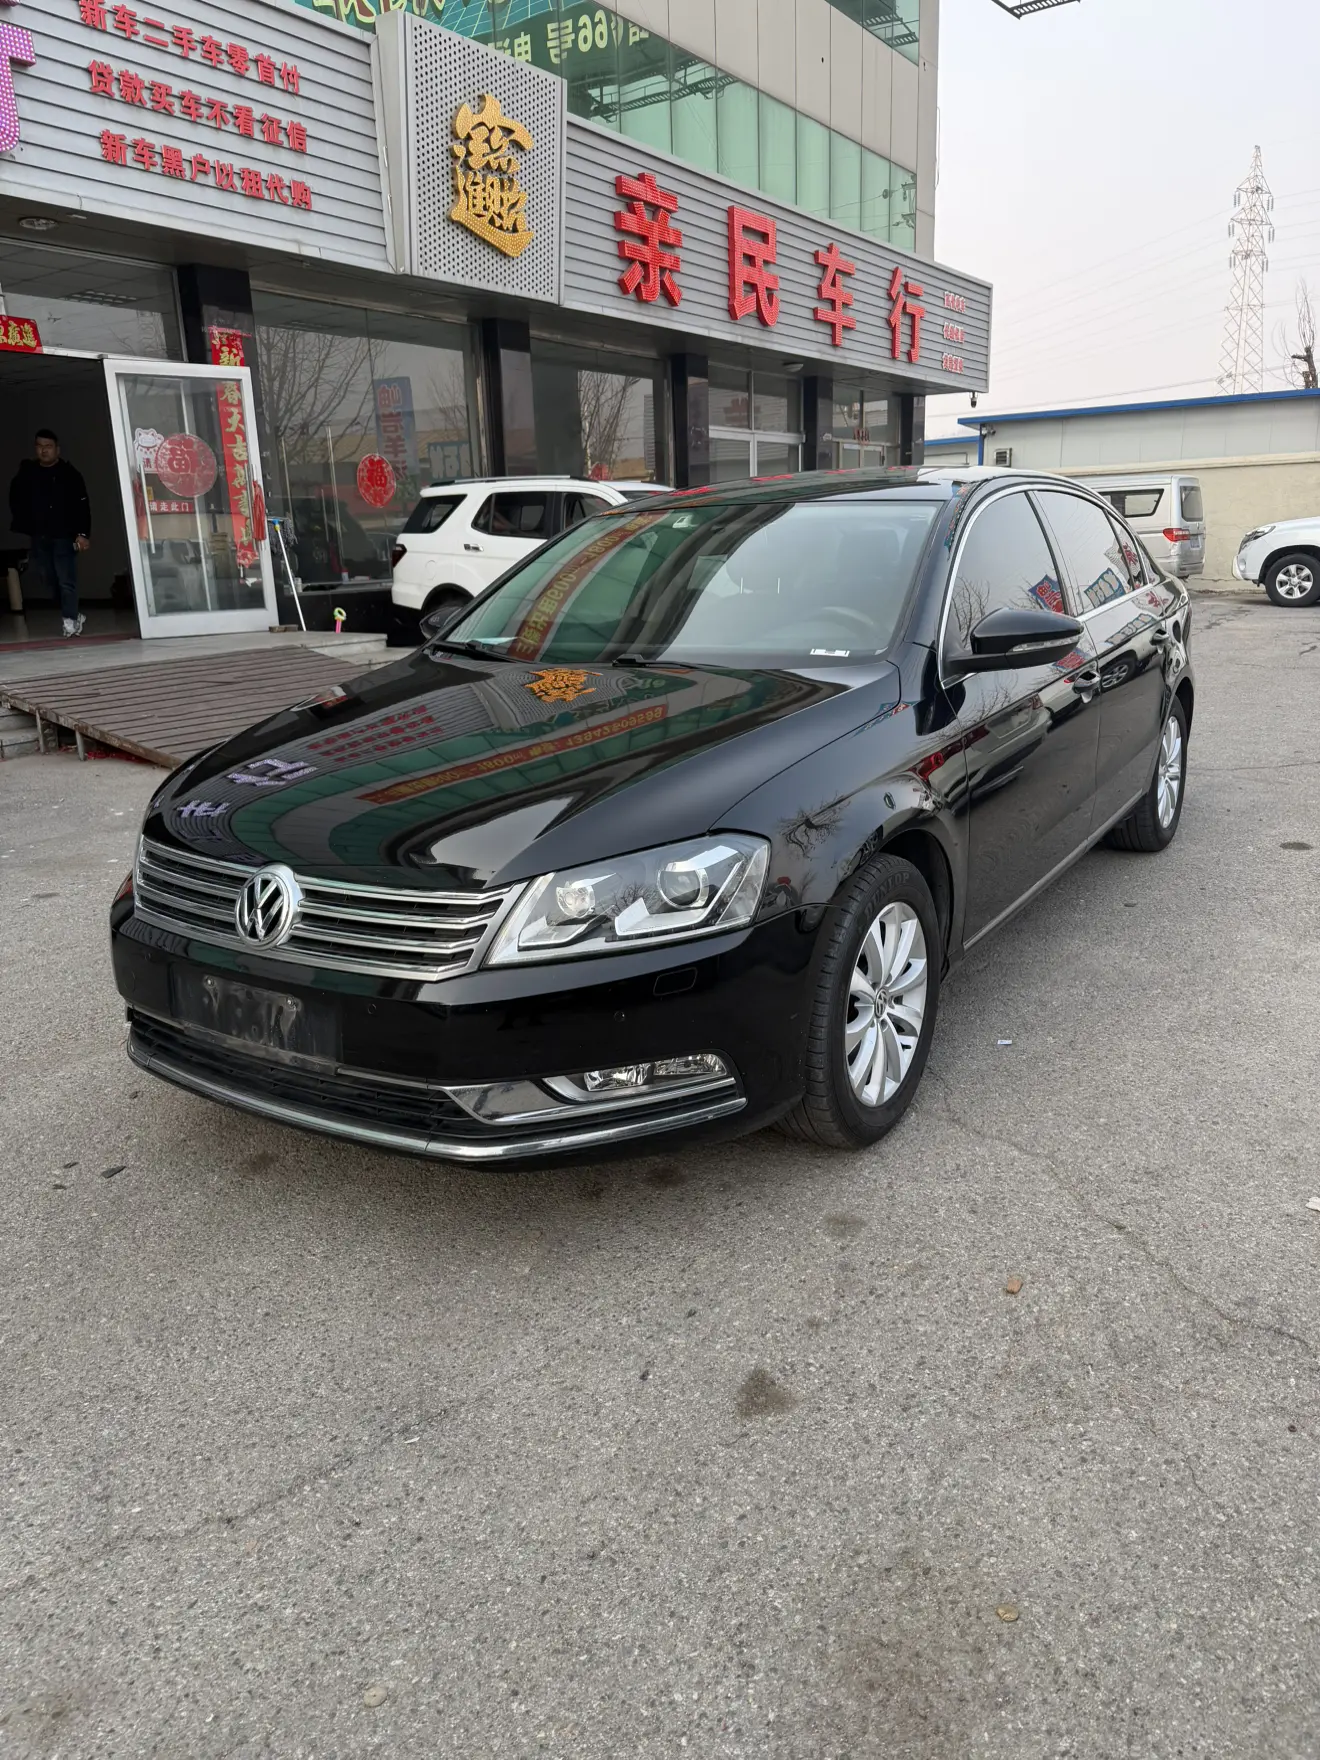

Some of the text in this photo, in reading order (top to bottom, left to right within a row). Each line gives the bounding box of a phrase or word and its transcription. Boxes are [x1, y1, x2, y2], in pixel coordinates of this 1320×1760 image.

[79, 0, 301, 95] 新车二手车零首付
[88, 59, 308, 154] 贷款买车不看征信
[100, 129, 313, 210] 新车黑户以租代购
[614, 172, 926, 364] 亲民车行
[149, 501, 189, 512] 请走此门
